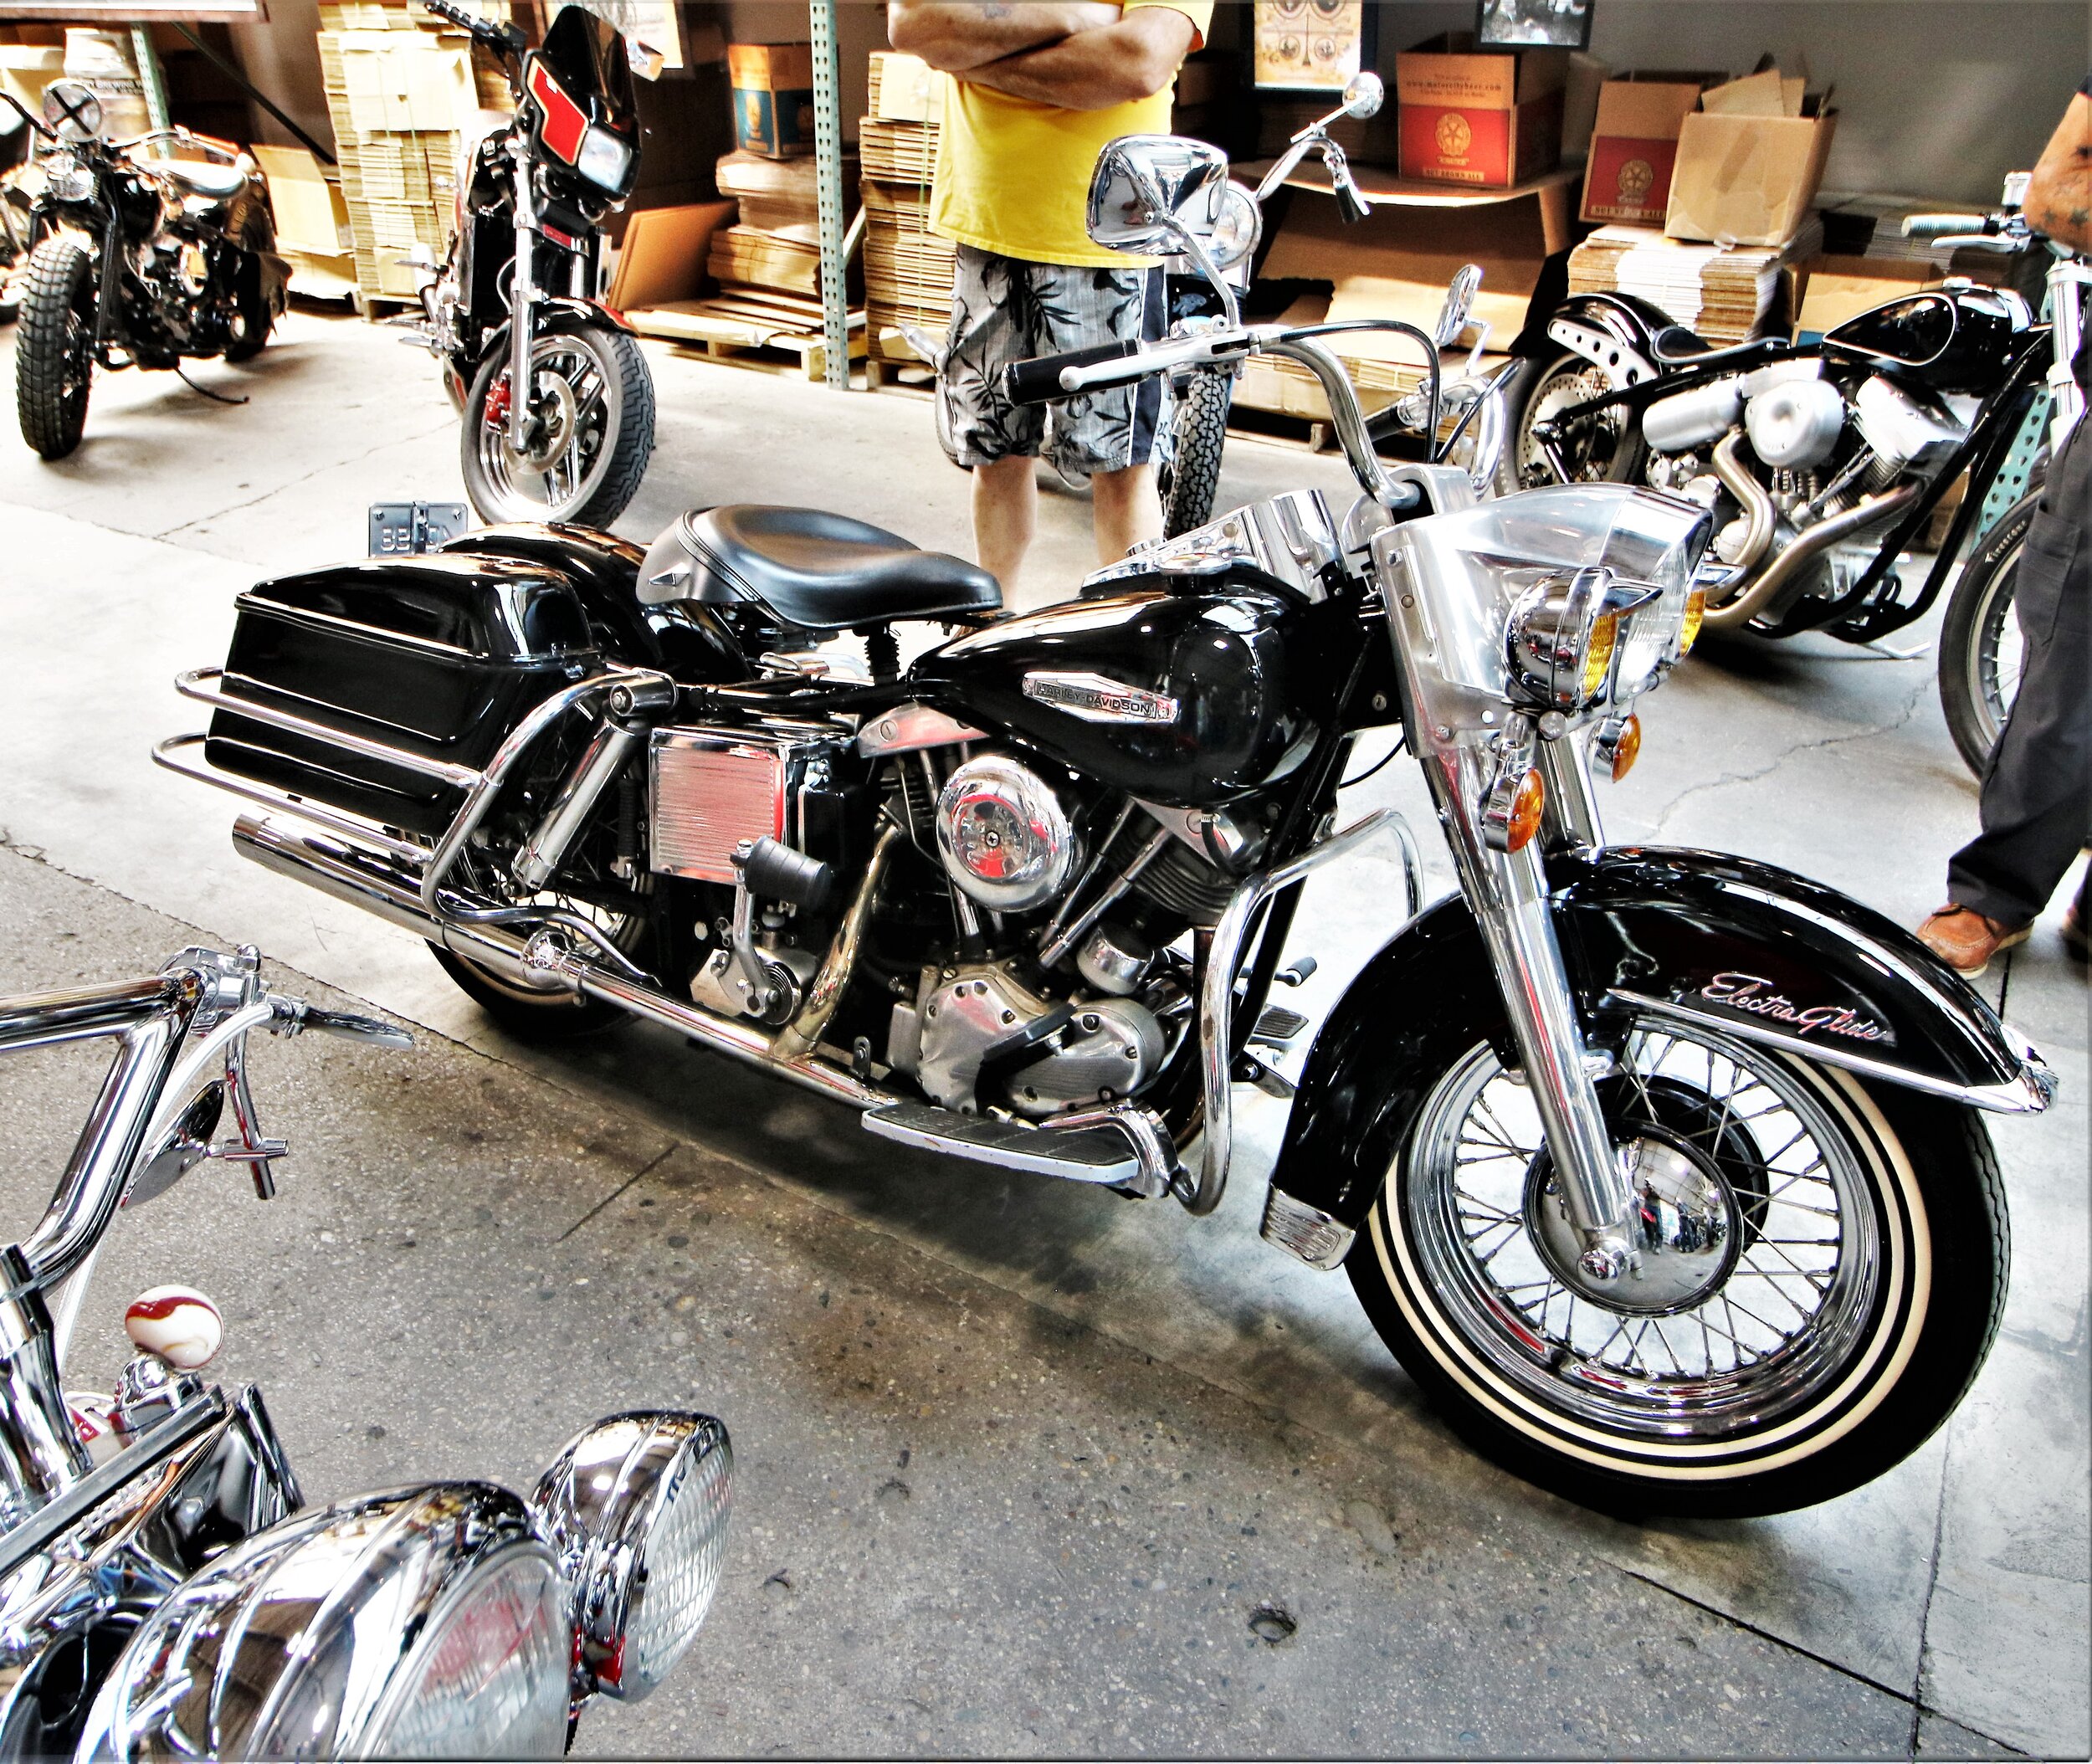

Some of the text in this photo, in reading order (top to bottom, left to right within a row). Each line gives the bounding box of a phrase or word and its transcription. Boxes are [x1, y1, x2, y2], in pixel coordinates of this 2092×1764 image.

[1038, 685, 1151, 715] HARLEY-DAVIDSON
[1701, 972, 1888, 1041] Electra Glide
